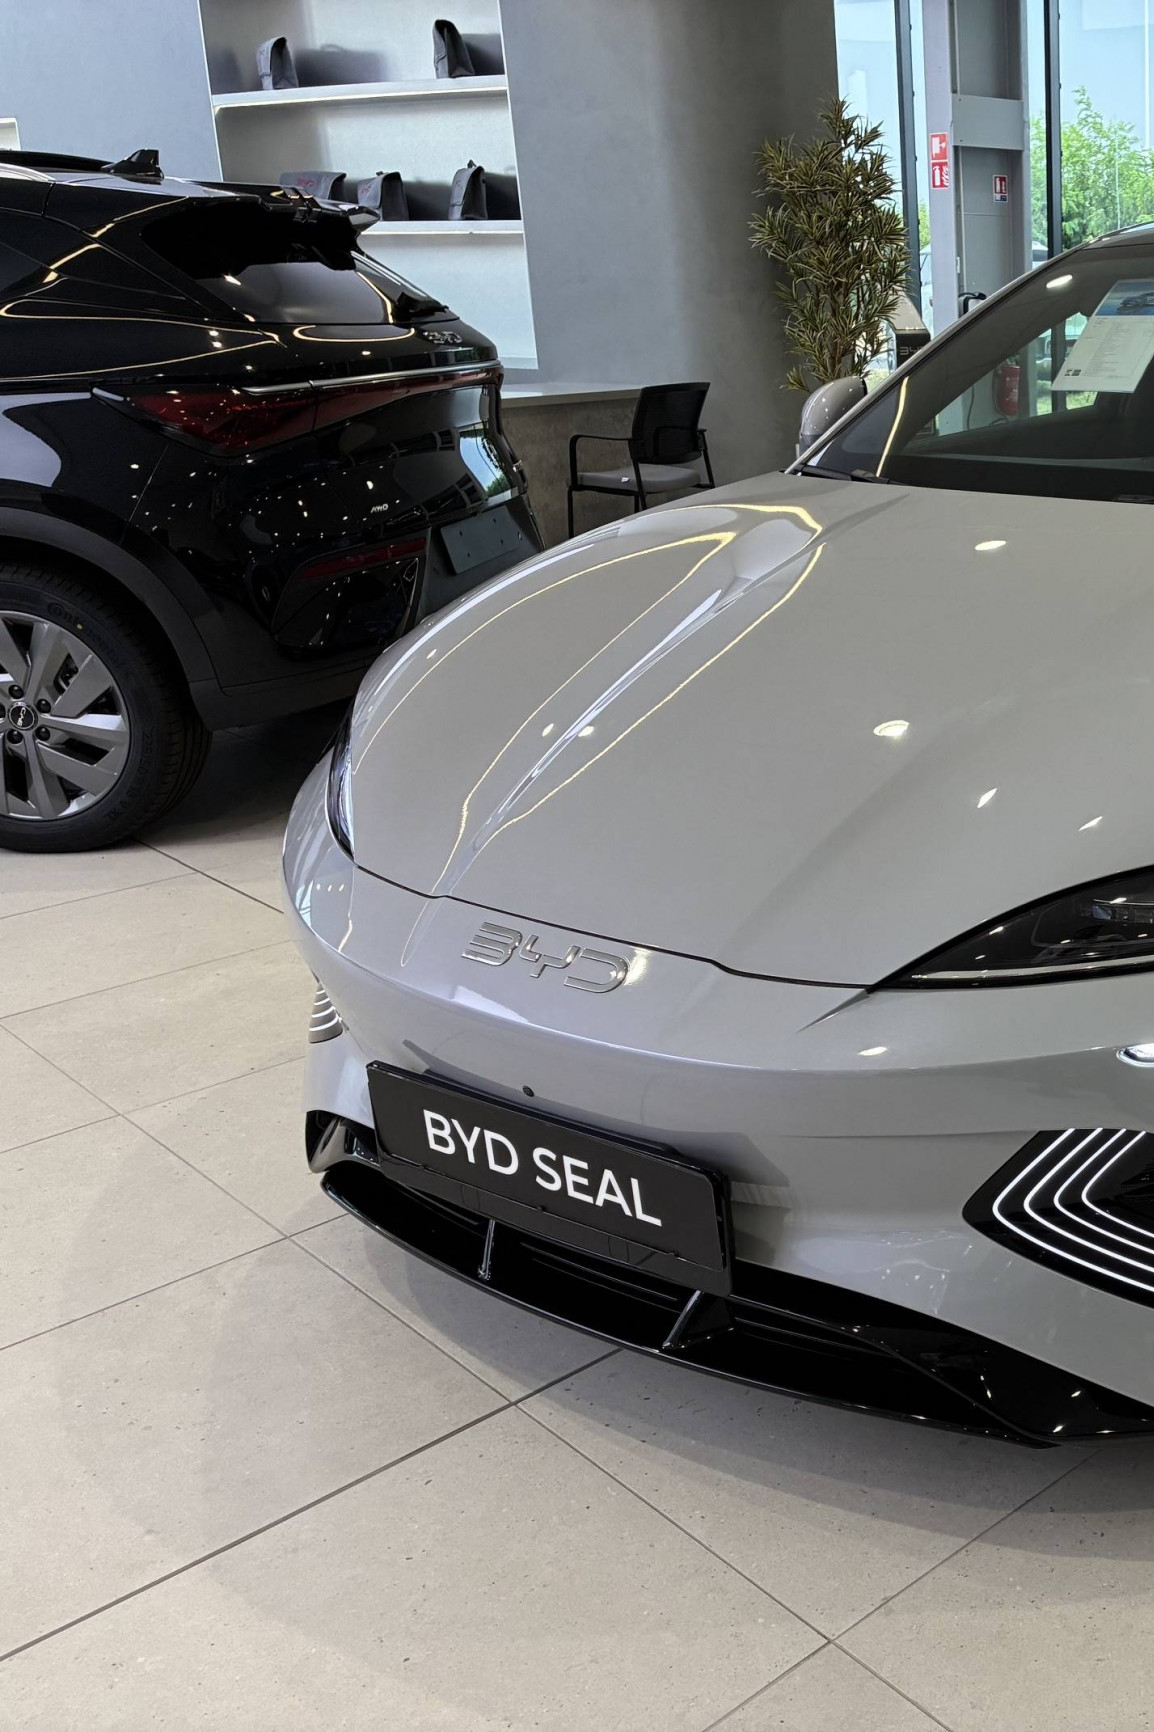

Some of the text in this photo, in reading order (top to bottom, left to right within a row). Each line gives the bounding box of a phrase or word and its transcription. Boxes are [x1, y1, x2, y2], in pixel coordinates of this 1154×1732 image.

[461, 920, 631, 994] BYD
[422, 1108, 663, 1227] BYD SEAL
